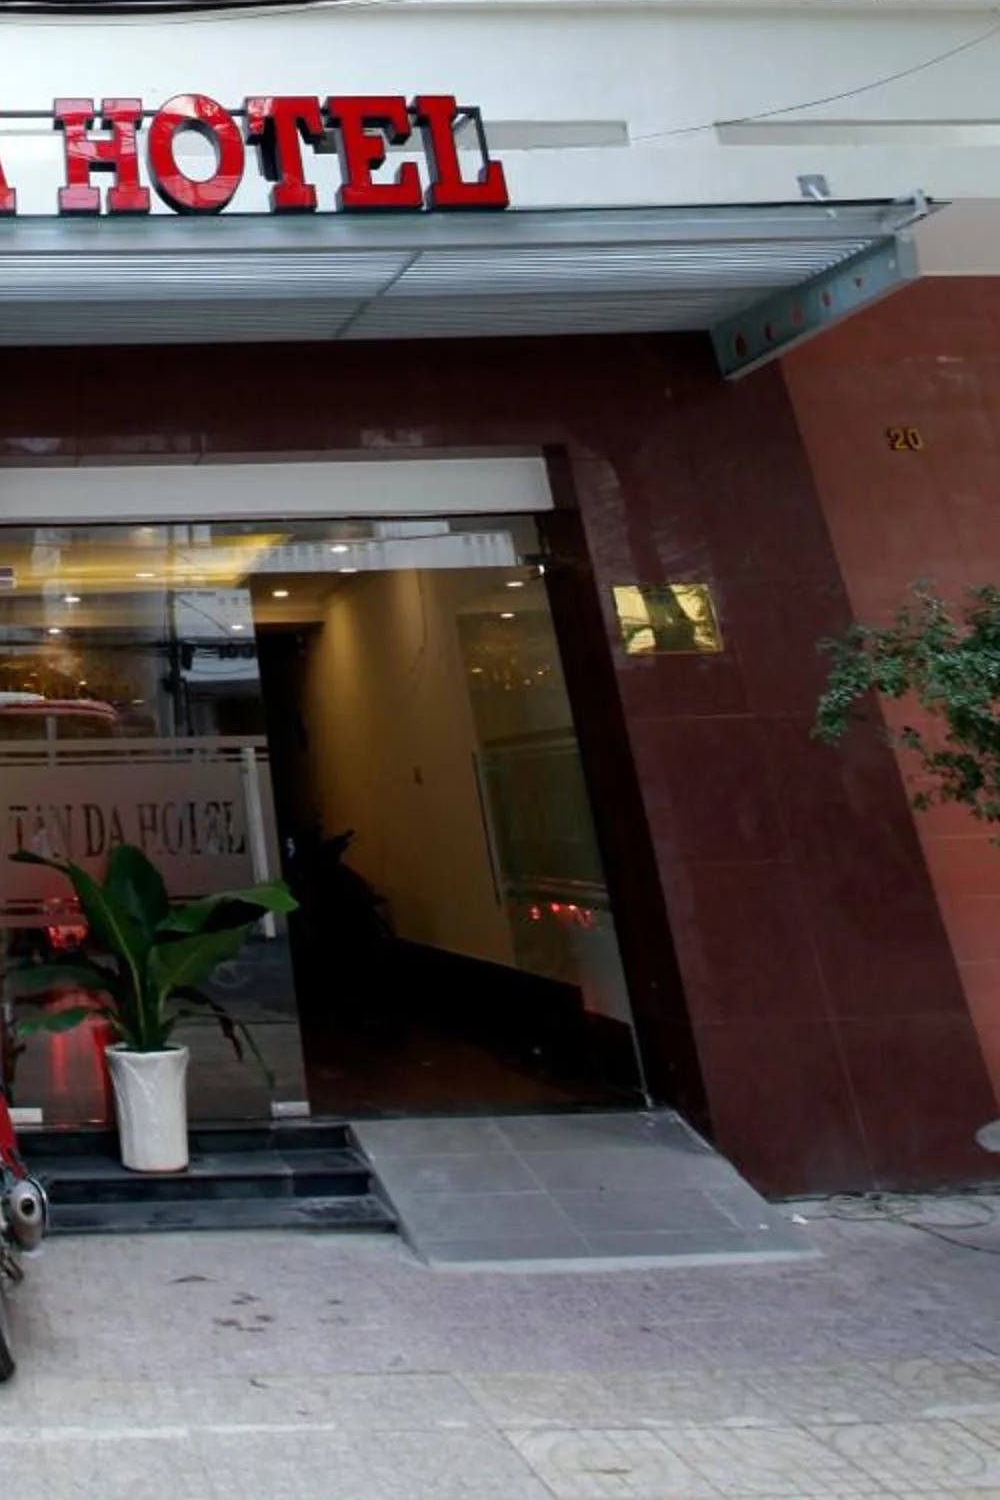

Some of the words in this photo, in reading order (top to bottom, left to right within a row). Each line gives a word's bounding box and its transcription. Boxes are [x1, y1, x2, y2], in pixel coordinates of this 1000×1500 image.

[53, 93, 510, 214] HOTEL
[887, 427, 923, 451] 20
[82, 803, 125, 858] DA
